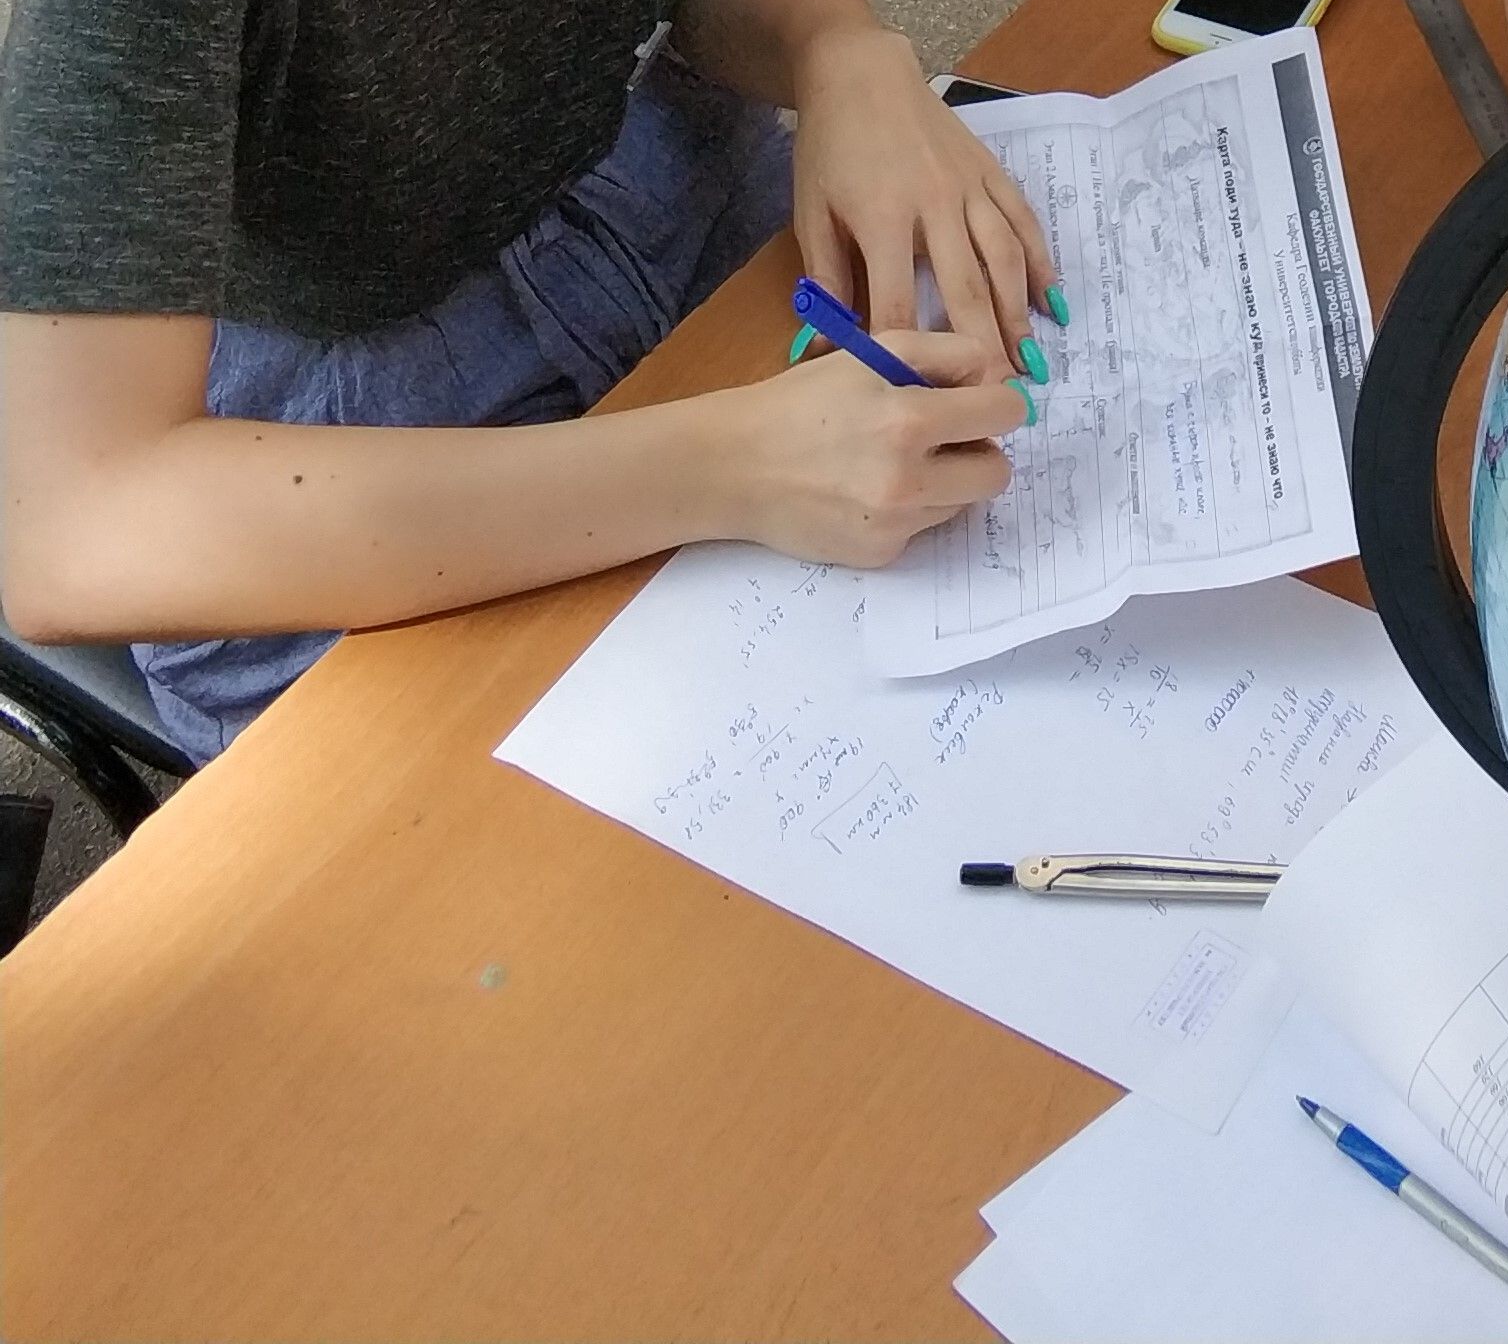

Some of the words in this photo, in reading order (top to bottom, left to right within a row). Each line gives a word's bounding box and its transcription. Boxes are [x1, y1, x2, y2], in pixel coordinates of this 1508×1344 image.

[1213, 125, 1234, 168] Карта
[1219, 169, 1240, 205] поди
[1225, 206, 1246, 240] туда
[1310, 156, 1343, 265] ГОСУДАРСТВЕННЫЙ
[1283, 211, 1306, 263] Кафедра
[1307, 208, 1331, 272] ФАКУЛЬТЕТ
[1235, 251, 1251, 273] не
[1238, 274, 1259, 319] знаю
[1250, 353, 1271, 401] принеси
[1257, 400, 1272, 417] то
[1260, 424, 1277, 442] не
[1263, 442, 1281, 475] знаю
[1268, 476, 1285, 500] что
